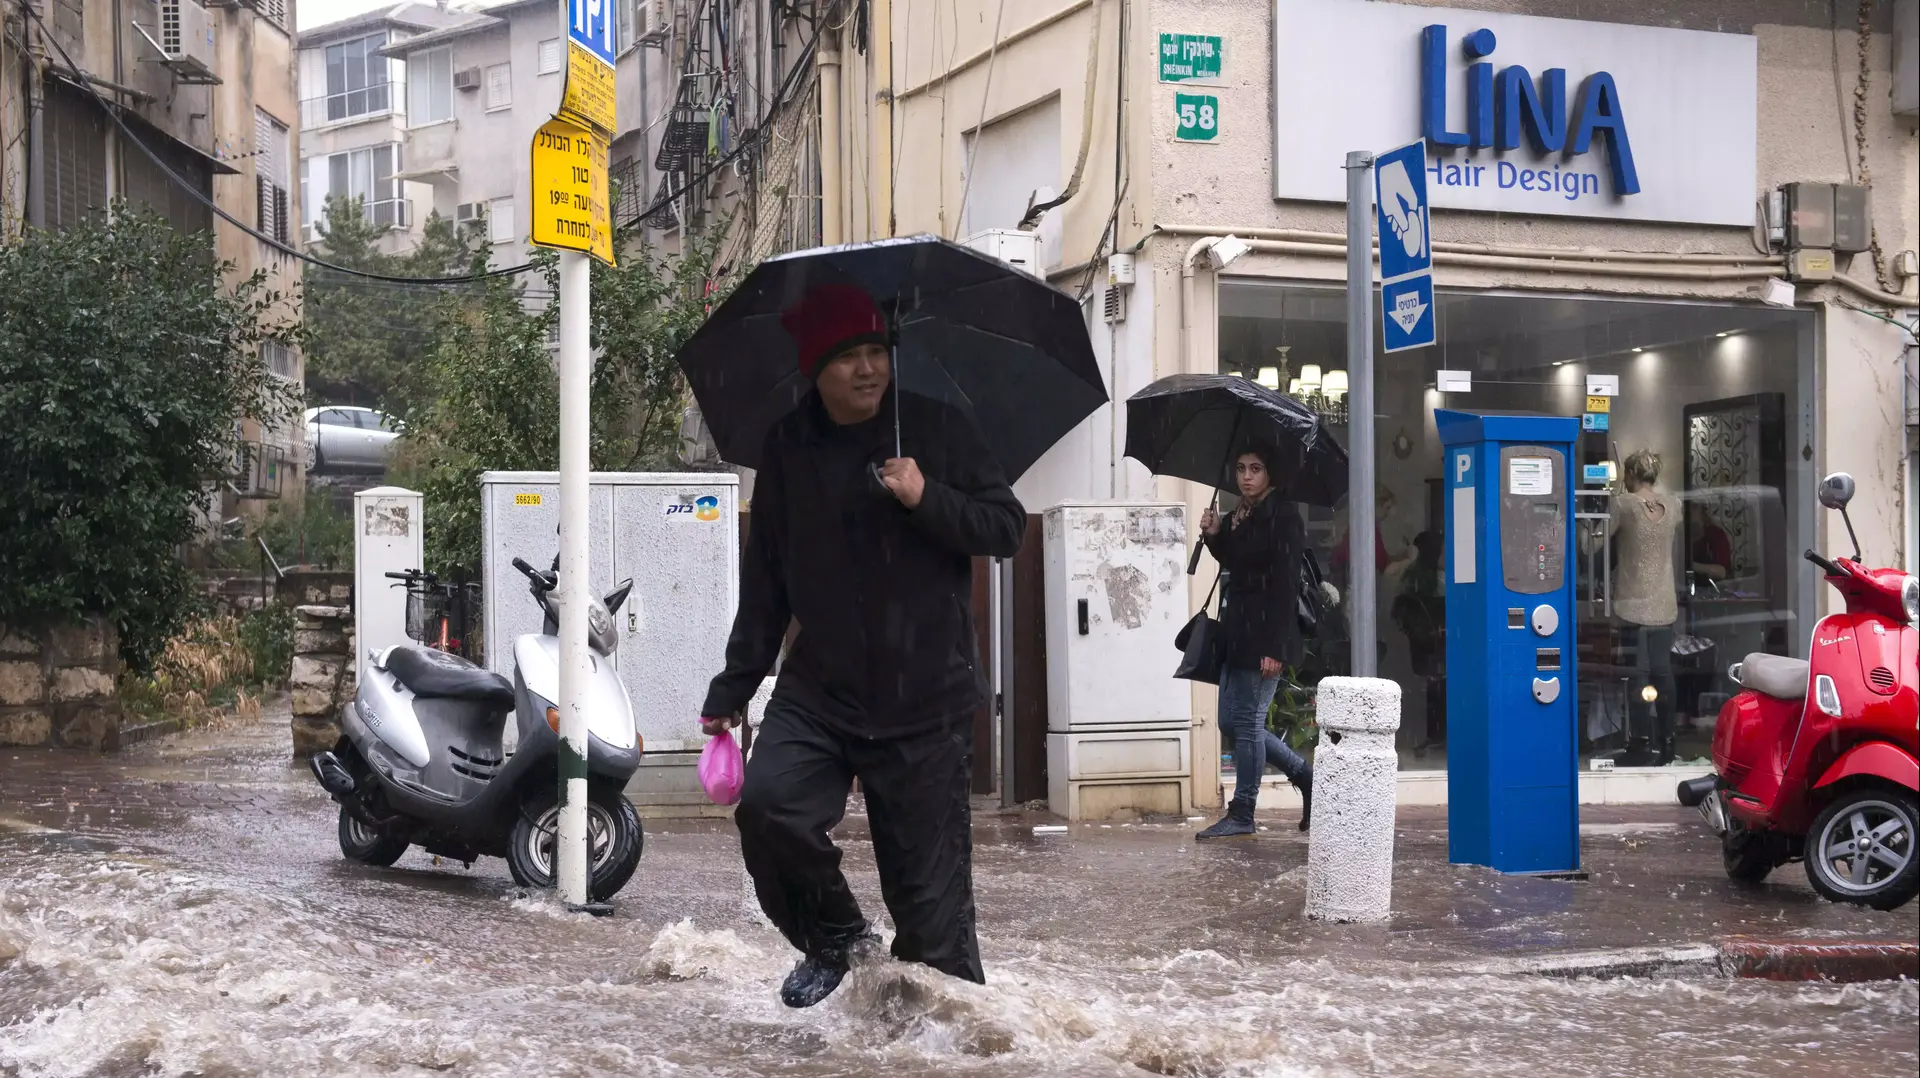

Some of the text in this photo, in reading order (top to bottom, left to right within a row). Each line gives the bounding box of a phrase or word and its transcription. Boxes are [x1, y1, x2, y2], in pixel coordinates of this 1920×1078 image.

[1164, 64, 1192, 76] SHEINKIN
[1180, 104, 1215, 129] 58
[540, 130, 570, 152] הכולל
[572, 166, 589, 184] טון
[1427, 158, 1599, 201] Hair Design
[557, 218, 591, 239] למחרת
[1402, 313, 1415, 325] חניה
[1456, 454, 1471, 482] P
[516, 495, 541, 505] 5662/90
[666, 502, 694, 515] בזק
